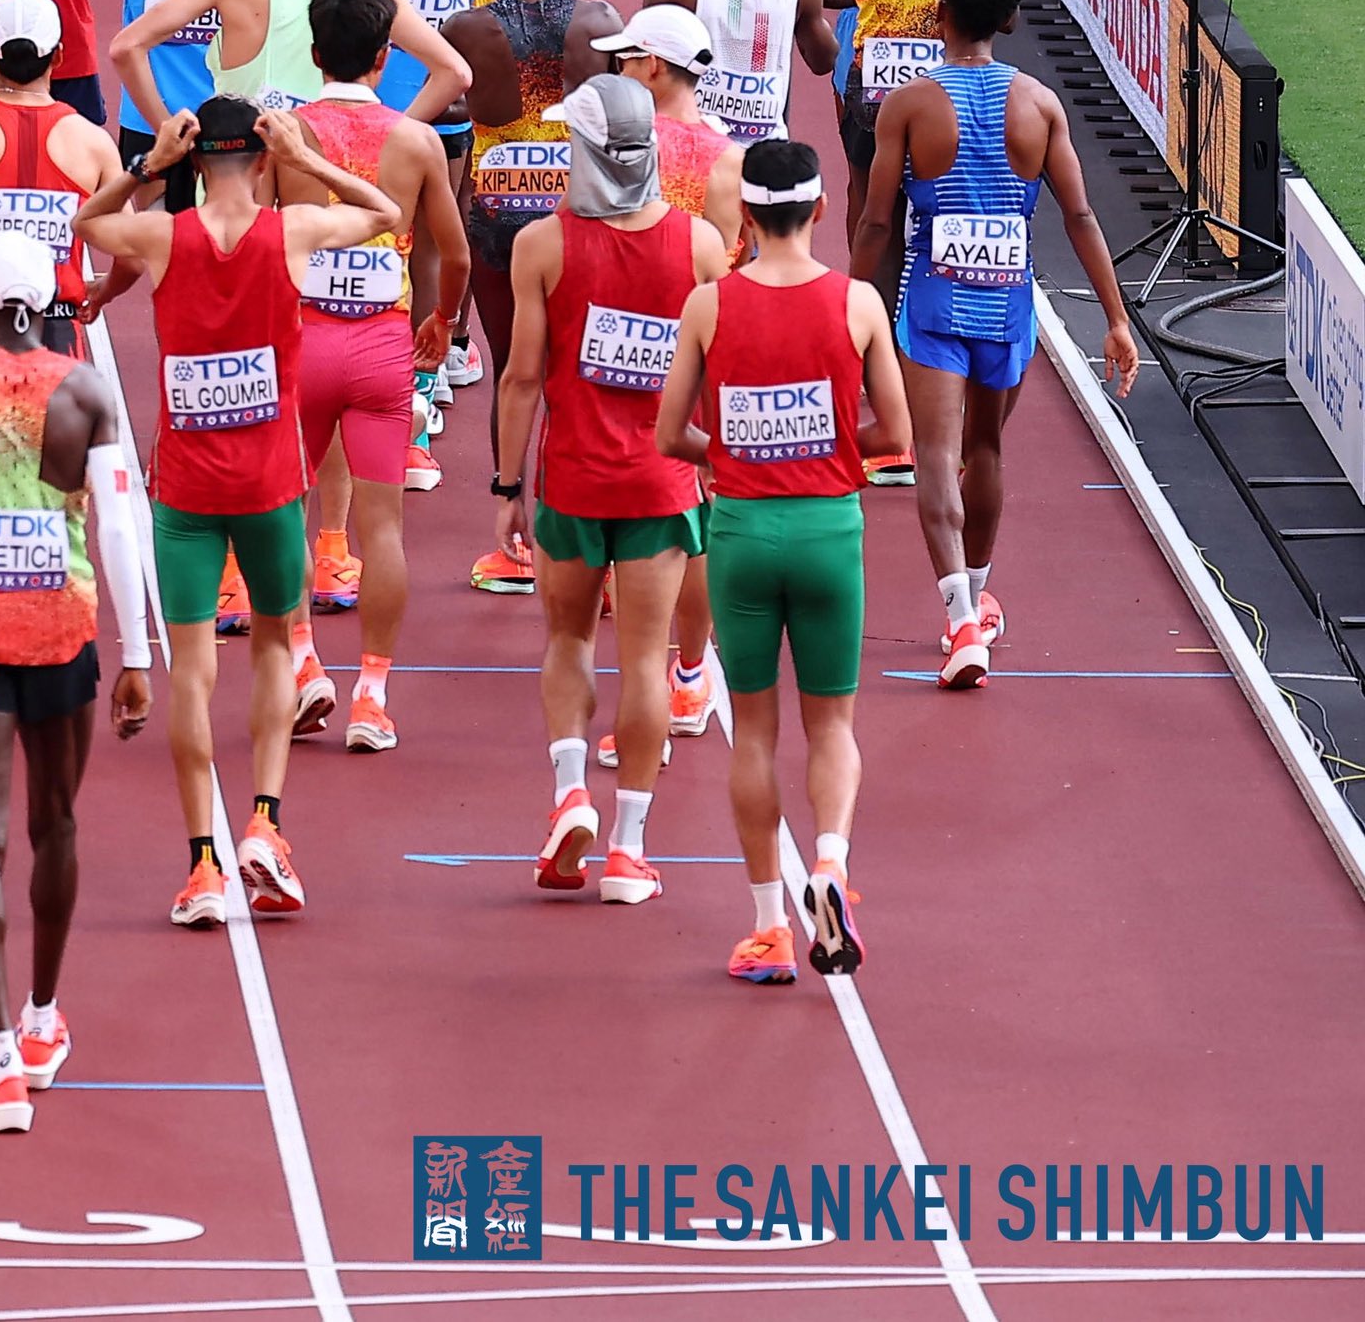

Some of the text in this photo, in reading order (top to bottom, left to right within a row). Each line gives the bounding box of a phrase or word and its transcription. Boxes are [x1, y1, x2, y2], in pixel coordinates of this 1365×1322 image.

[891, 43, 944, 63] TDK
[722, 72, 776, 95] TDK
[695, 89, 778, 119] CHIAPPINELLI
[506, 146, 569, 166] TDK
[2, 193, 68, 215] TDK
[964, 219, 1021, 239] TDK
[330, 250, 391, 271] TDK
[941, 242, 1020, 267] AYALE
[329, 276, 366, 298] HE
[619, 316, 680, 342] TDK
[1296, 240, 1326, 405] TDK
[193, 352, 266, 378] TDK
[587, 339, 674, 370] EL AARAB
[172, 379, 273, 410] EL GOUMRI
[749, 388, 822, 412] TDK
[727, 413, 830, 443] BOUQANTAR
